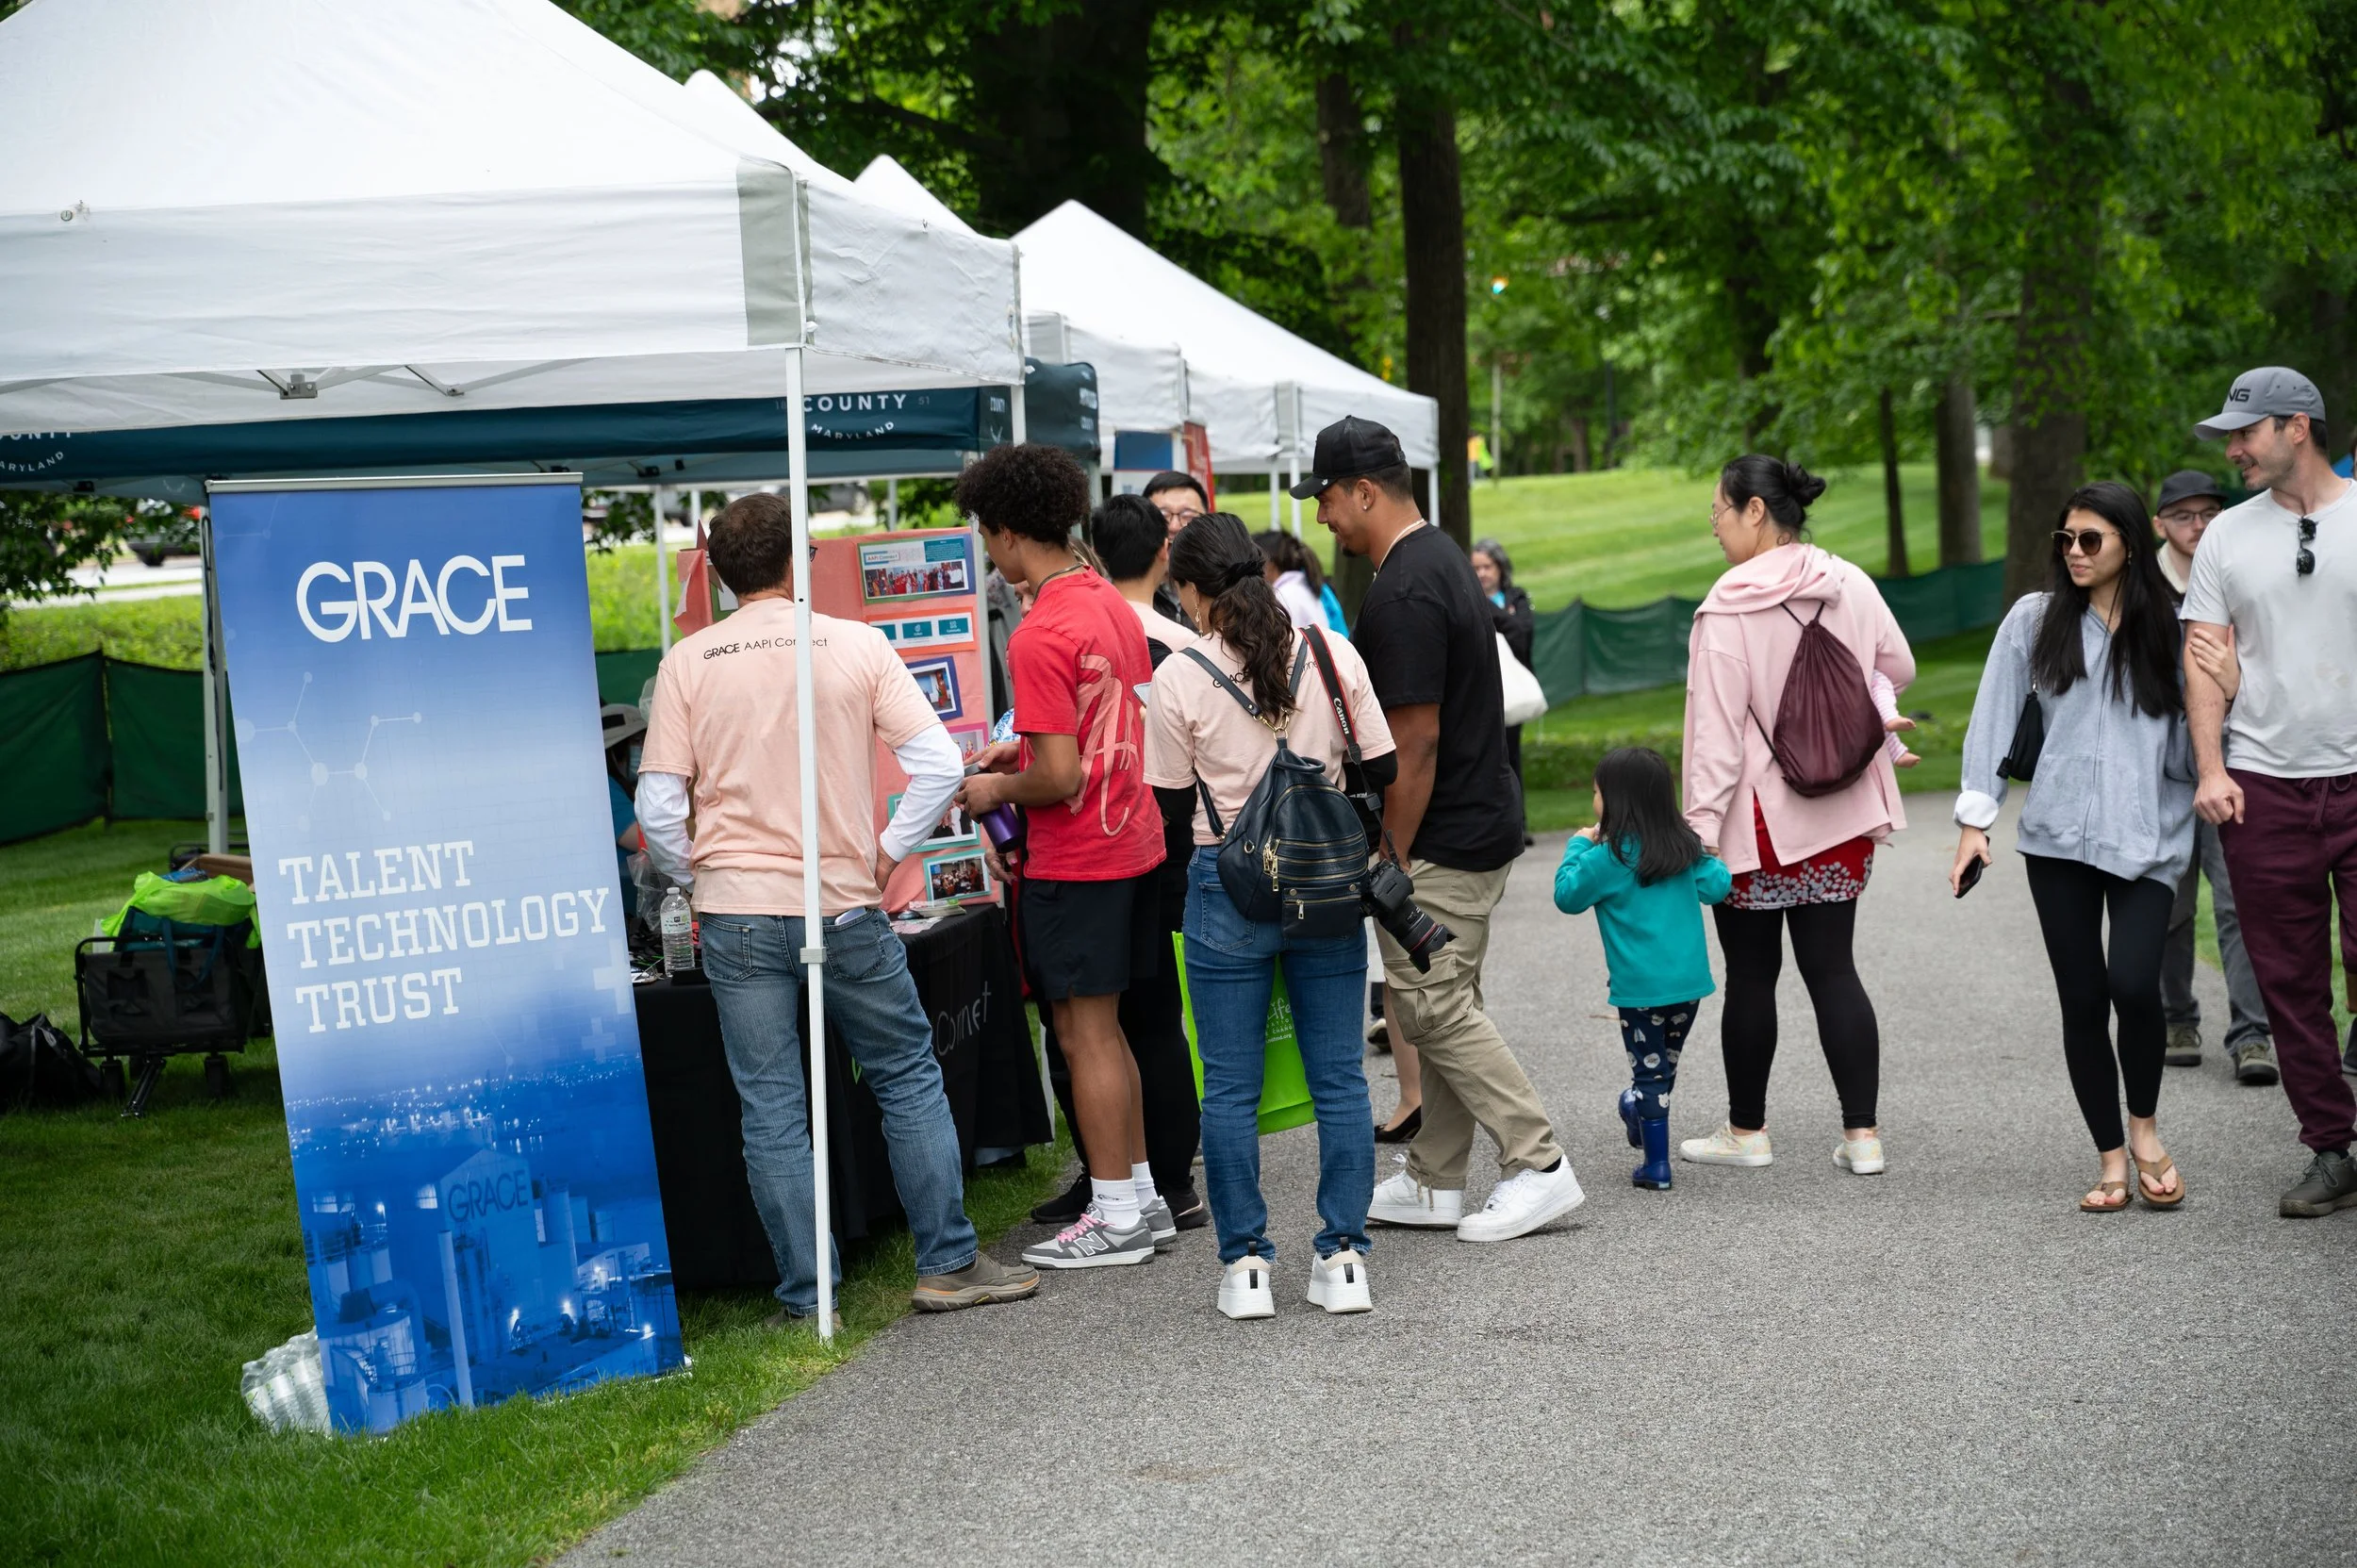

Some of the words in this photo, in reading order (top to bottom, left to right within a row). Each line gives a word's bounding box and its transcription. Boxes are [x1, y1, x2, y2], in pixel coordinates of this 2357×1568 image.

[803, 394, 907, 412] COUNTY
[2229, 388, 2251, 403] NG
[0, 451, 64, 472] ARYLAND
[296, 554, 533, 643] GRACE
[703, 643, 740, 660] GRACE
[744, 639, 772, 651] AAPI
[775, 637, 828, 648] Coct
[1212, 671, 1249, 688] GACE
[1334, 698, 1349, 734] Canon
[278, 840, 474, 905] TALENT
[287, 887, 609, 969] TECHNOLOGY
[295, 967, 462, 1033] TRUST
[448, 1169, 529, 1223] GRACE
